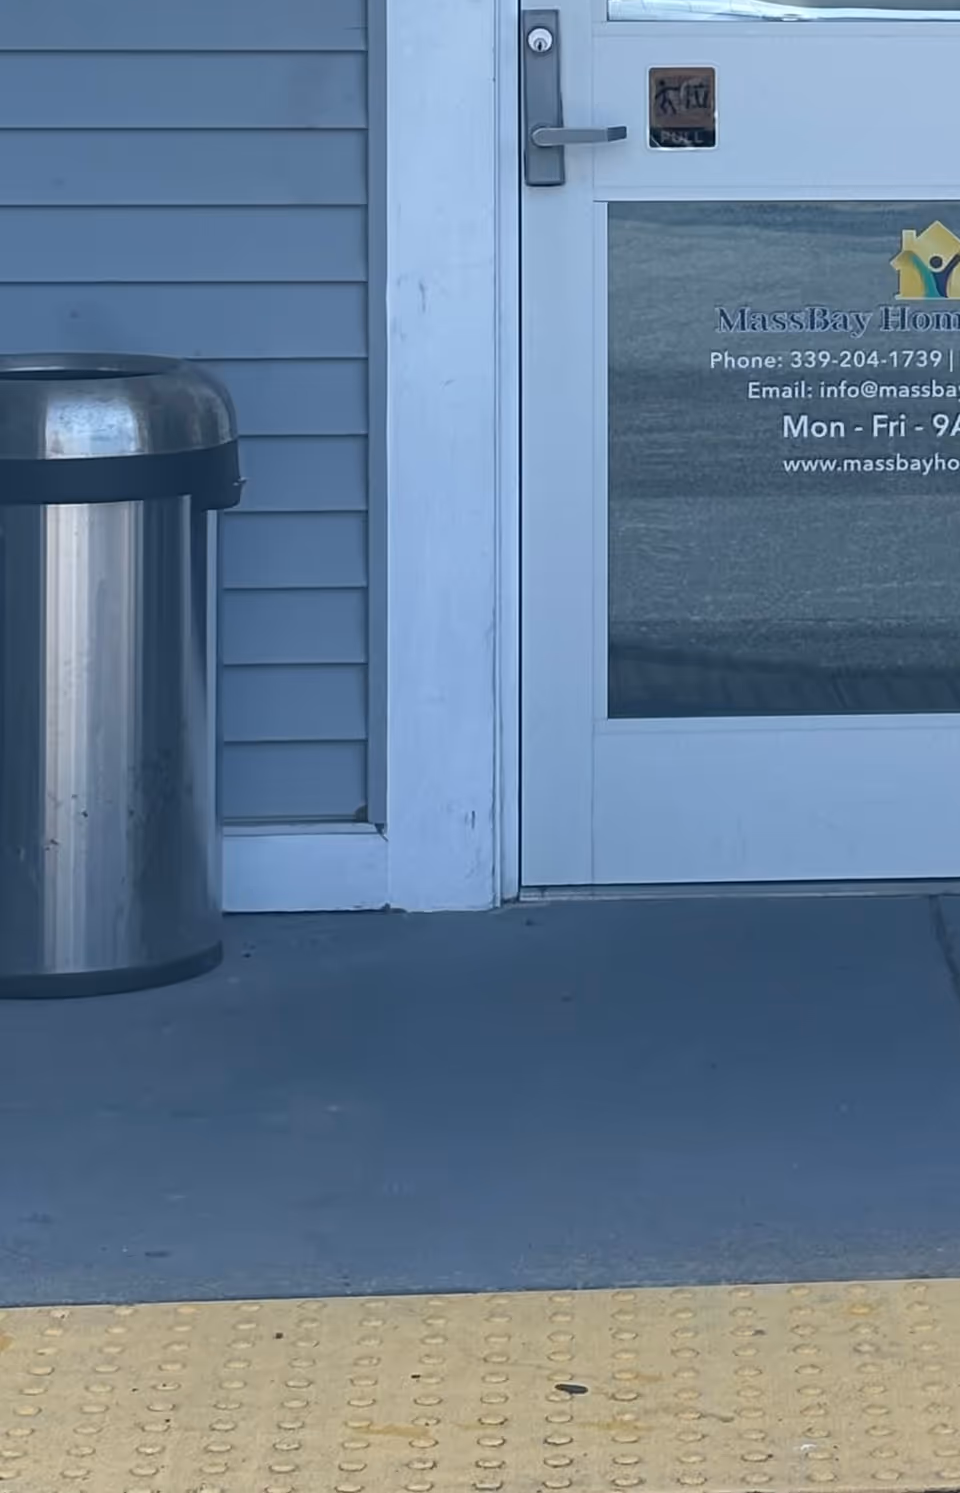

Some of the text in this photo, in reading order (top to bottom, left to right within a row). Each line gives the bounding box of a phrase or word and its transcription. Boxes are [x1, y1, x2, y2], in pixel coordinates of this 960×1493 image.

[661, 130, 704, 144] PULL
[714, 305, 870, 339] MassBay
[709, 351, 783, 369] Phone:
[790, 351, 943, 369] 339-204-1739
[748, 381, 813, 400] Email:
[783, 415, 845, 438] Mon
[872, 413, 906, 437] Fri
